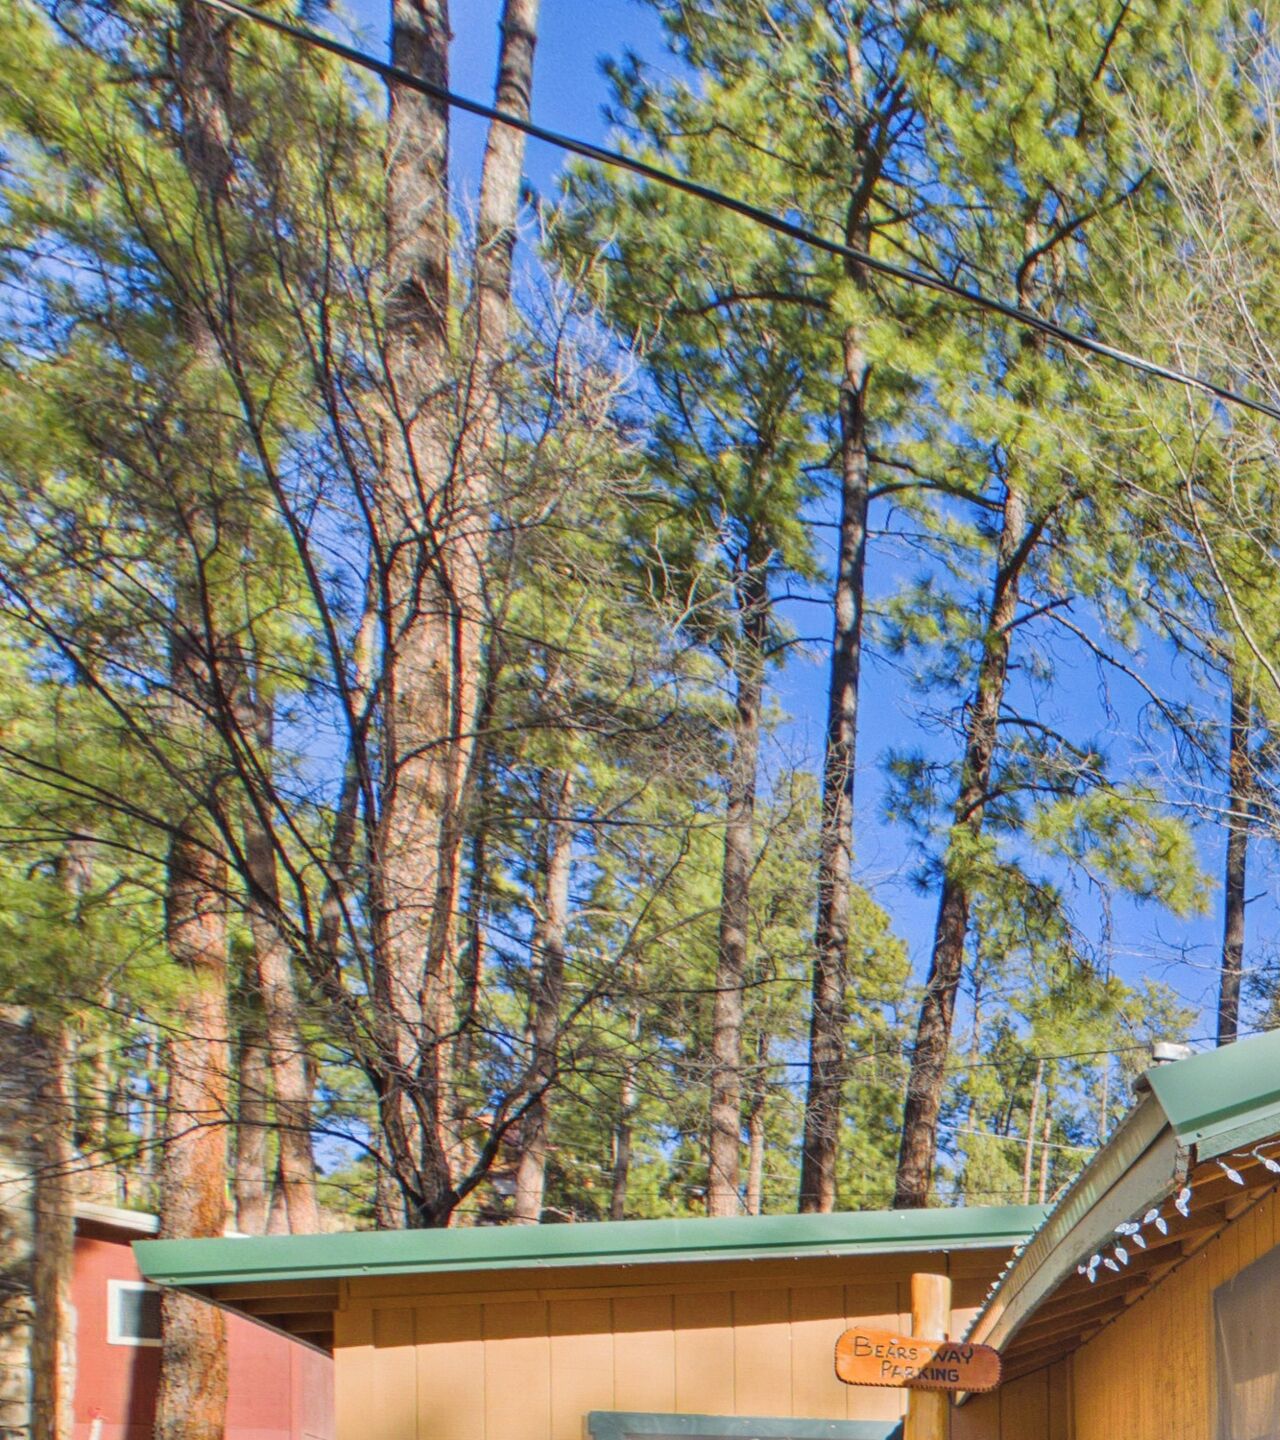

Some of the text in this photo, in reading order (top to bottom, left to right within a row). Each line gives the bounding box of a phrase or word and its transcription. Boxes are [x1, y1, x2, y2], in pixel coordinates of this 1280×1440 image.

[854, 1335, 974, 1365] BEARS WAY
[881, 1360, 961, 1382] PARKING
